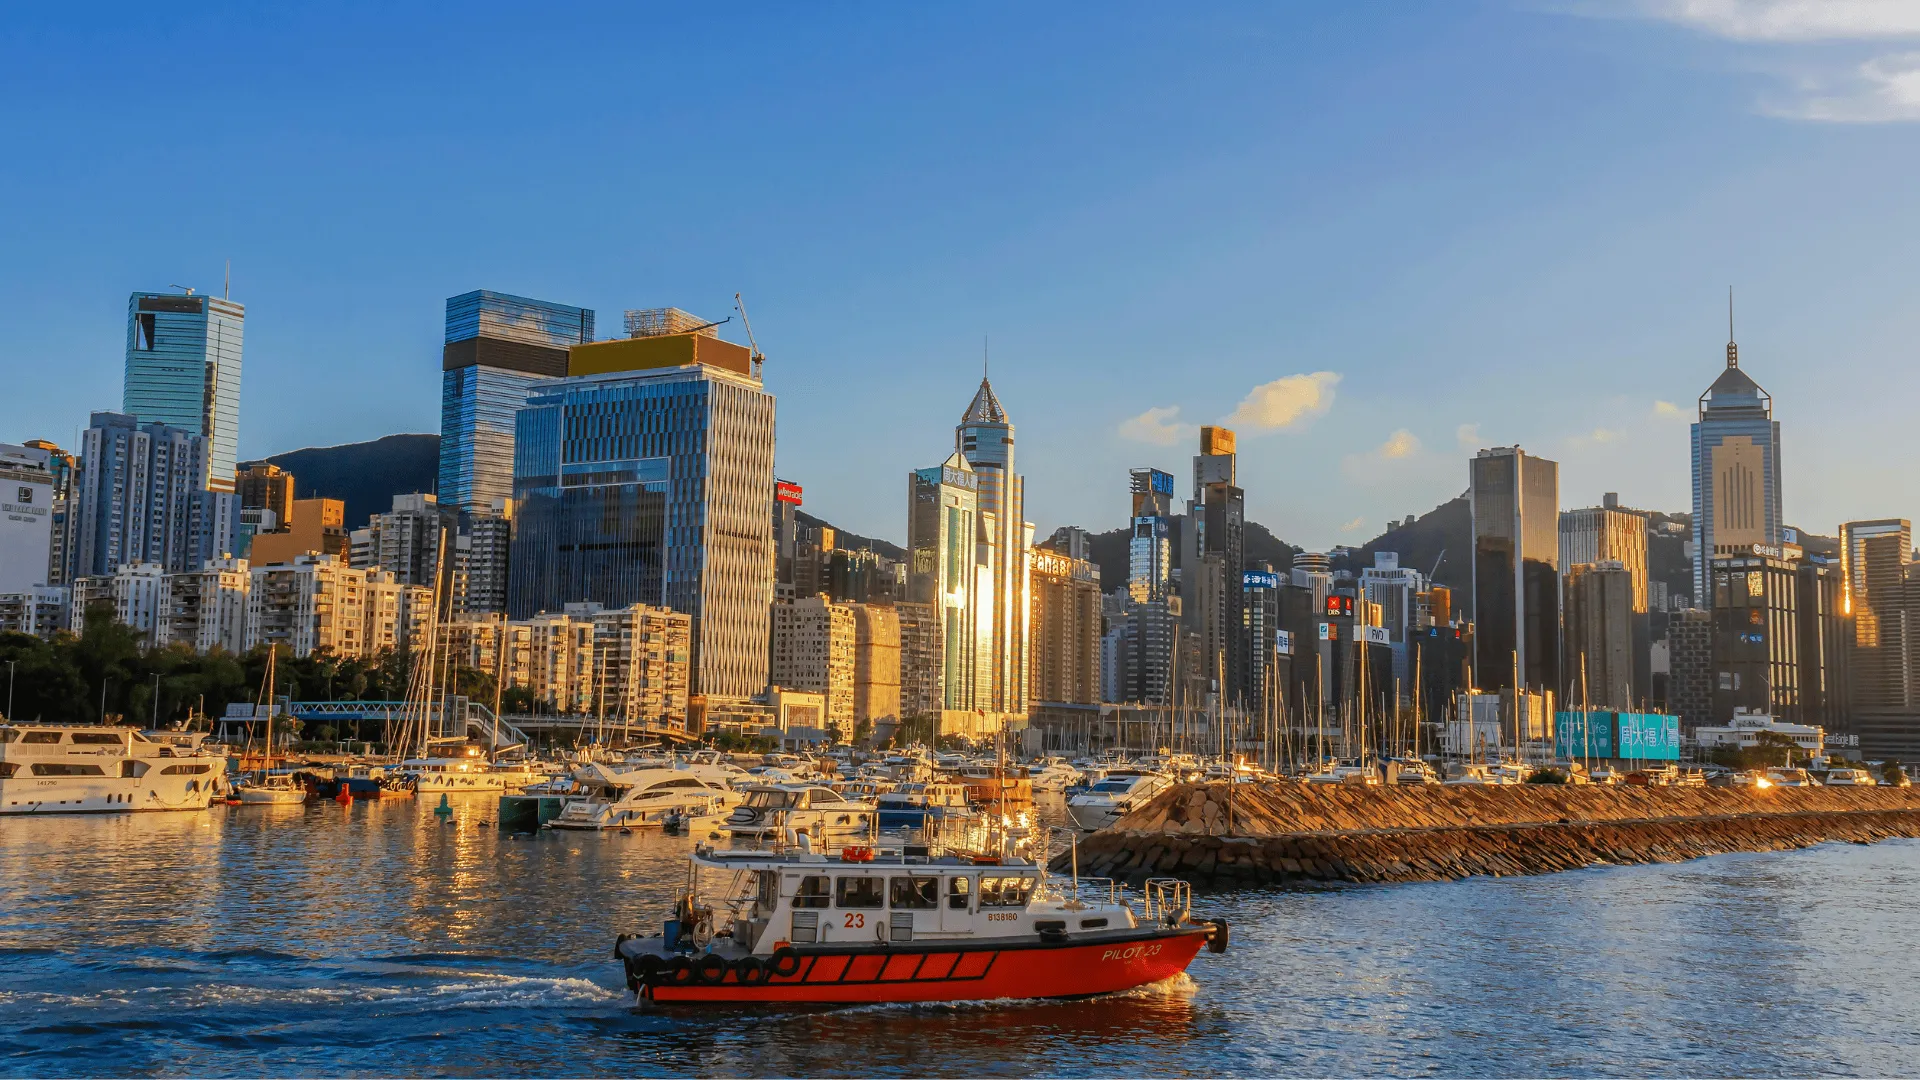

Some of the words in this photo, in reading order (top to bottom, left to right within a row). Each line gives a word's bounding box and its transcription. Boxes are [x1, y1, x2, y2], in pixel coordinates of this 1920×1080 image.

[1620, 726, 1679, 747] 周大福人壽
[844, 912, 865, 929] 23
[1101, 946, 1145, 961] PILOT
[1143, 944, 1162, 957] 23
